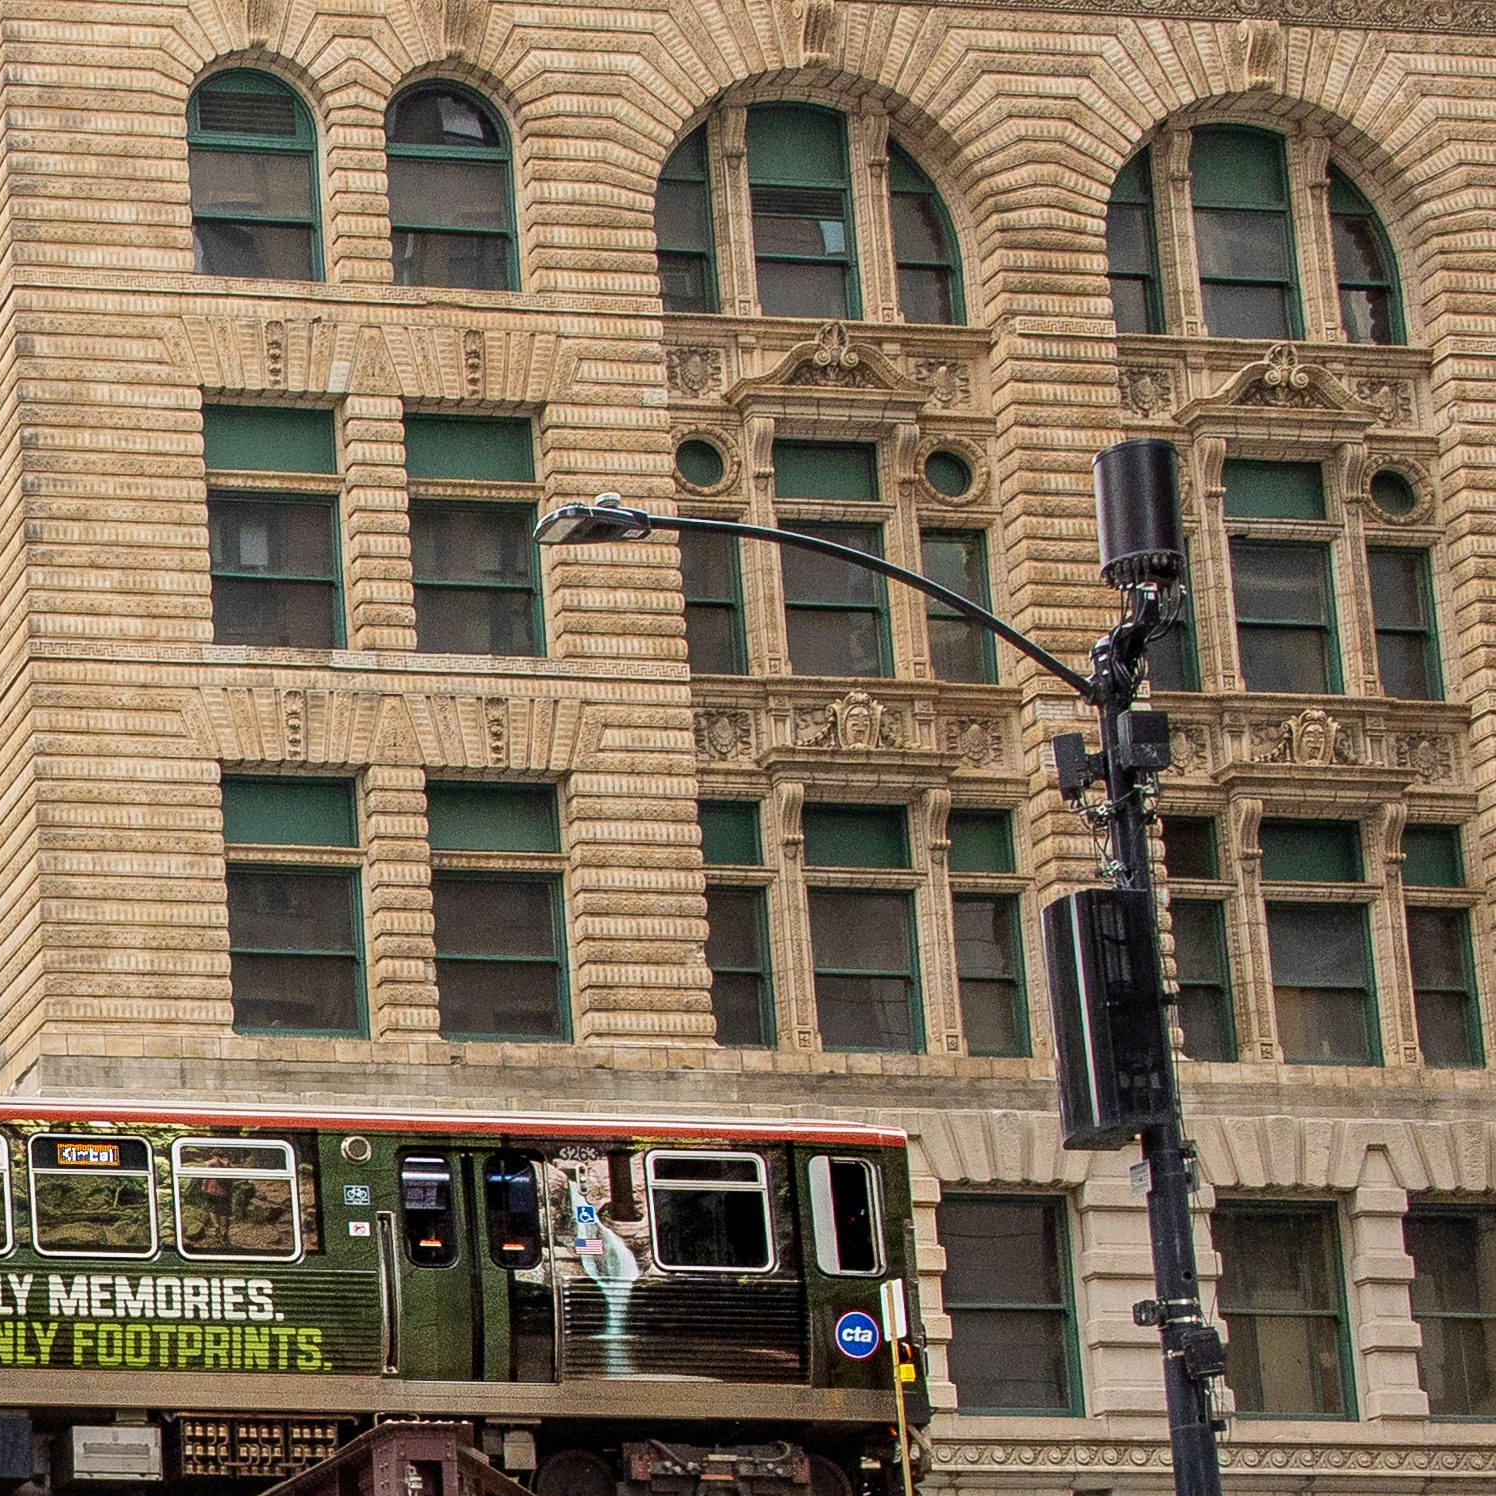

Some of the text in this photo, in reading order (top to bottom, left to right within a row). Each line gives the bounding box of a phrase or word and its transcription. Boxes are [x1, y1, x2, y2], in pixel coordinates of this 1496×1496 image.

[49, 1275, 285, 1321] MEMORIES.
[73, 1322, 333, 1371] FOOTPRINTS.
[841, 1326, 873, 1342] cta
